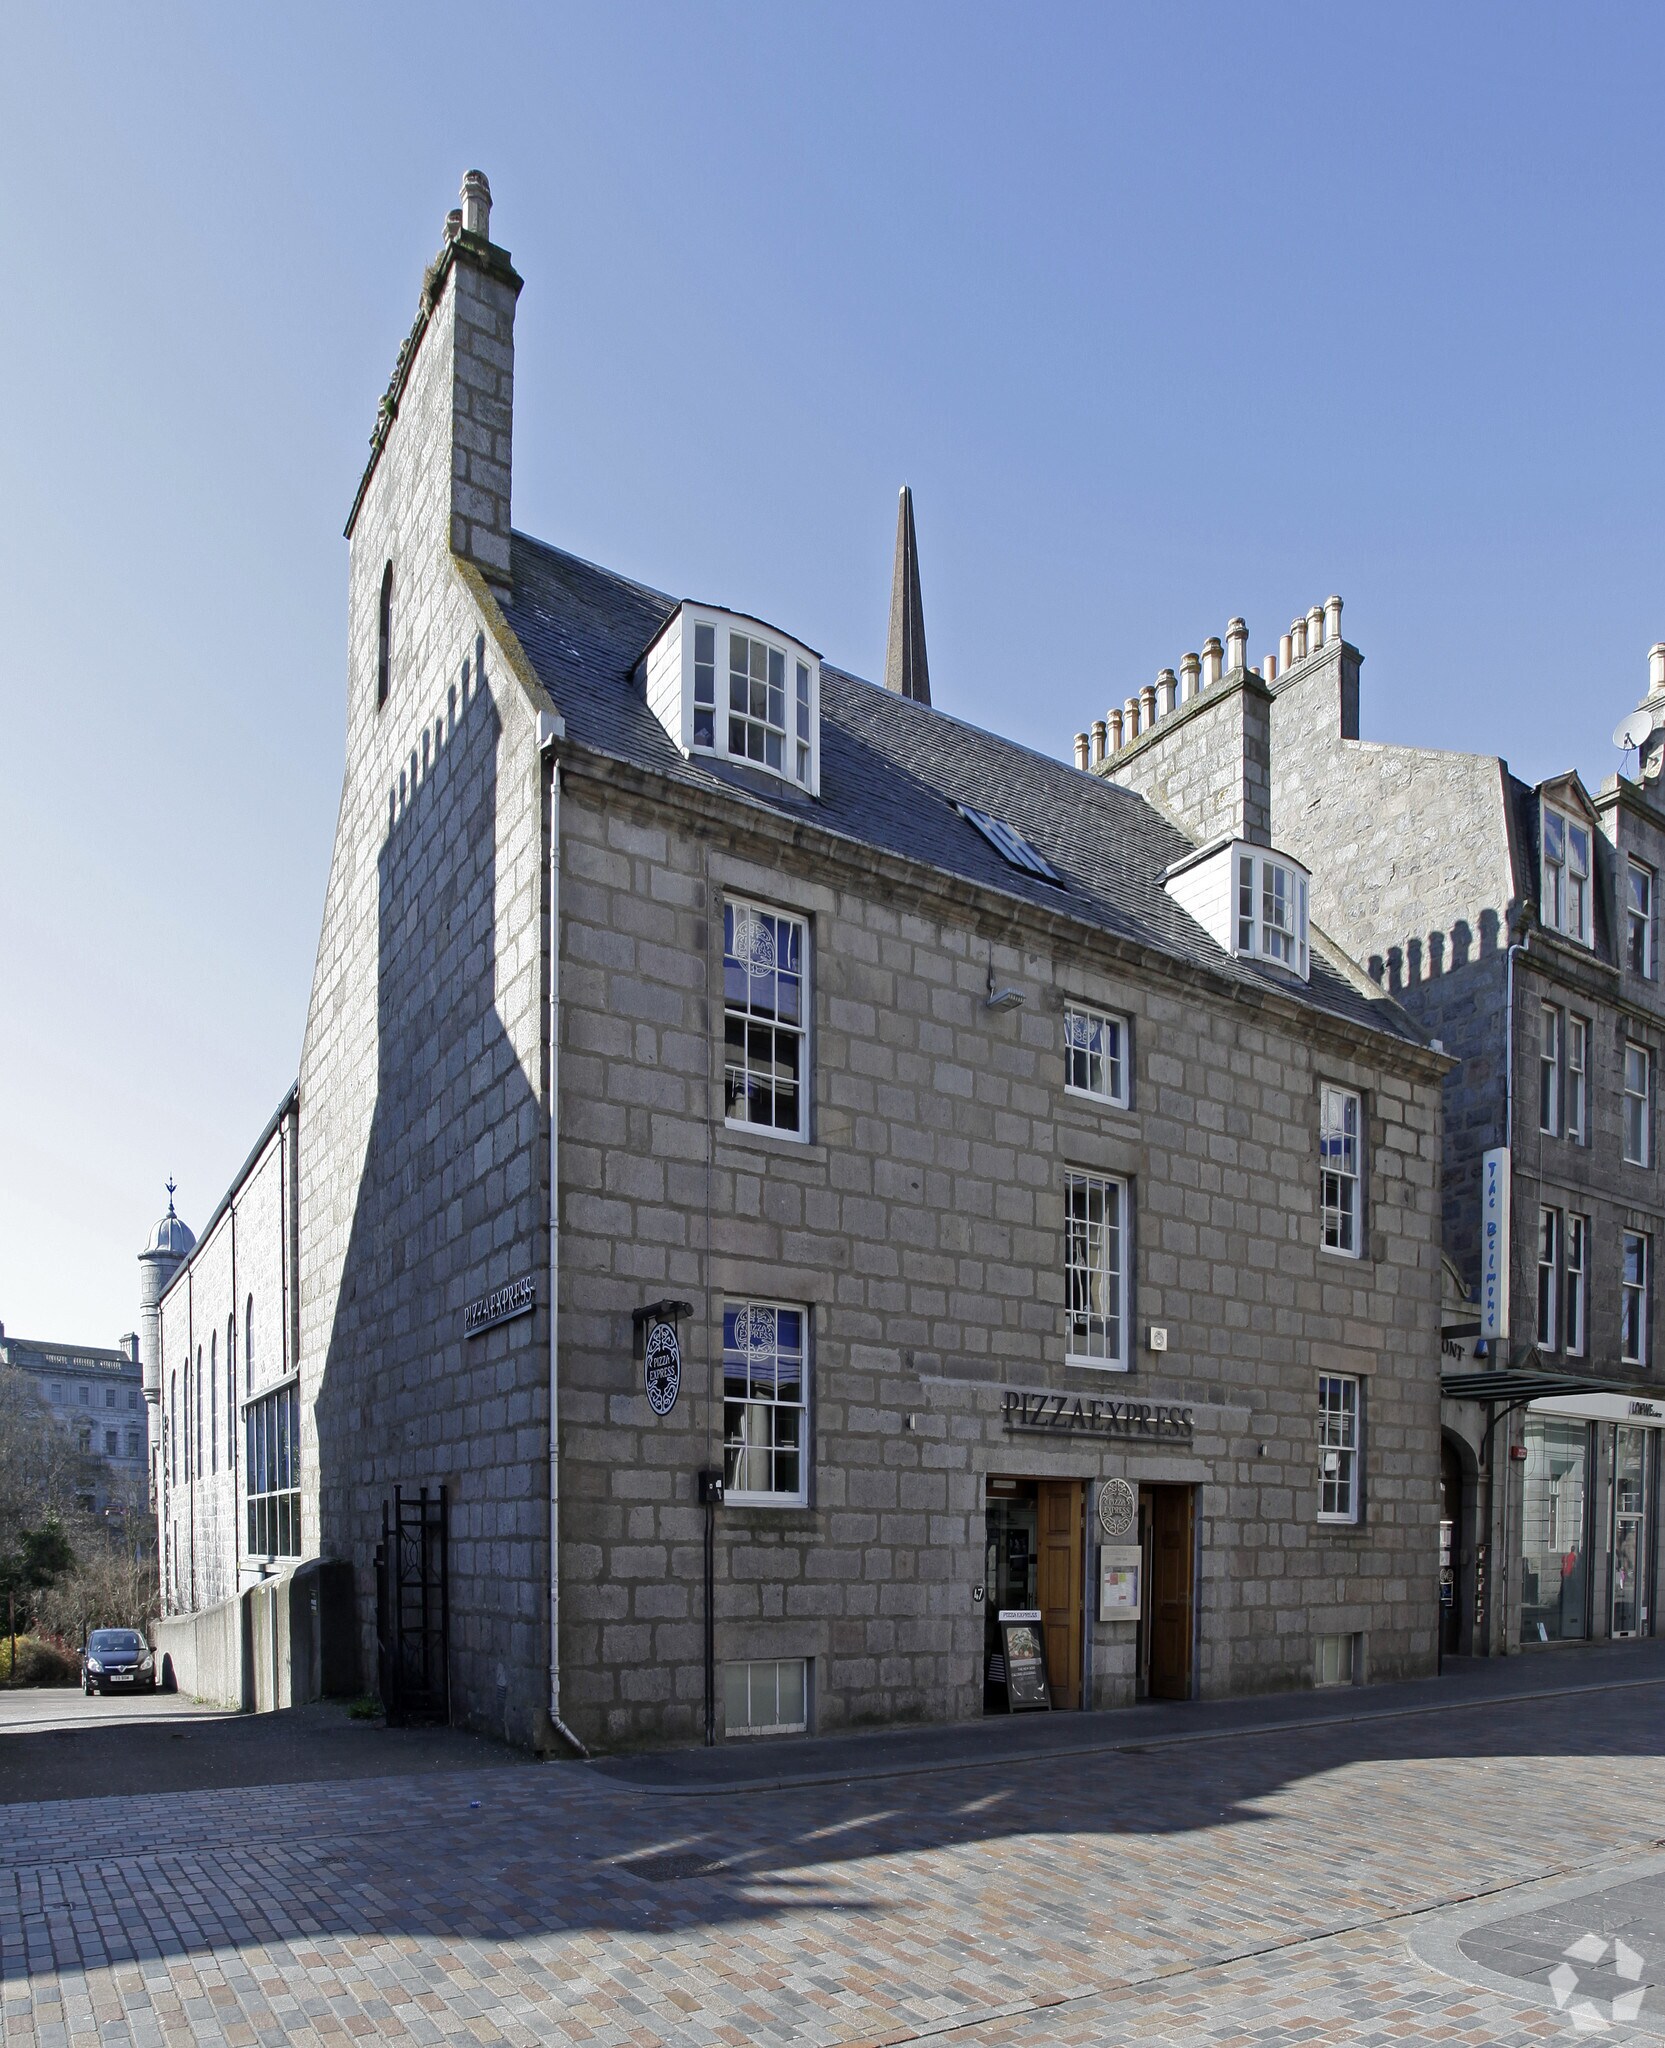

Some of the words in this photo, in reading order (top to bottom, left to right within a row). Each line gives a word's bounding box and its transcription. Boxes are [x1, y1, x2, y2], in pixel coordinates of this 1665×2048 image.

[1488, 1161, 1497, 1208] The
[1486, 1221, 1497, 1328] Belmont
[463, 1276, 532, 1330] PIZZAEXPRESS
[653, 1355, 670, 1368] PIZZA
[649, 1365, 676, 1380] EXPRESS
[1003, 1391, 1194, 1437] PIZZAEXPRESS
[1108, 1498, 1126, 1506] PIZZA
[1103, 1506, 1130, 1514] EXPRESS
[973, 1588, 983, 1600] 47
